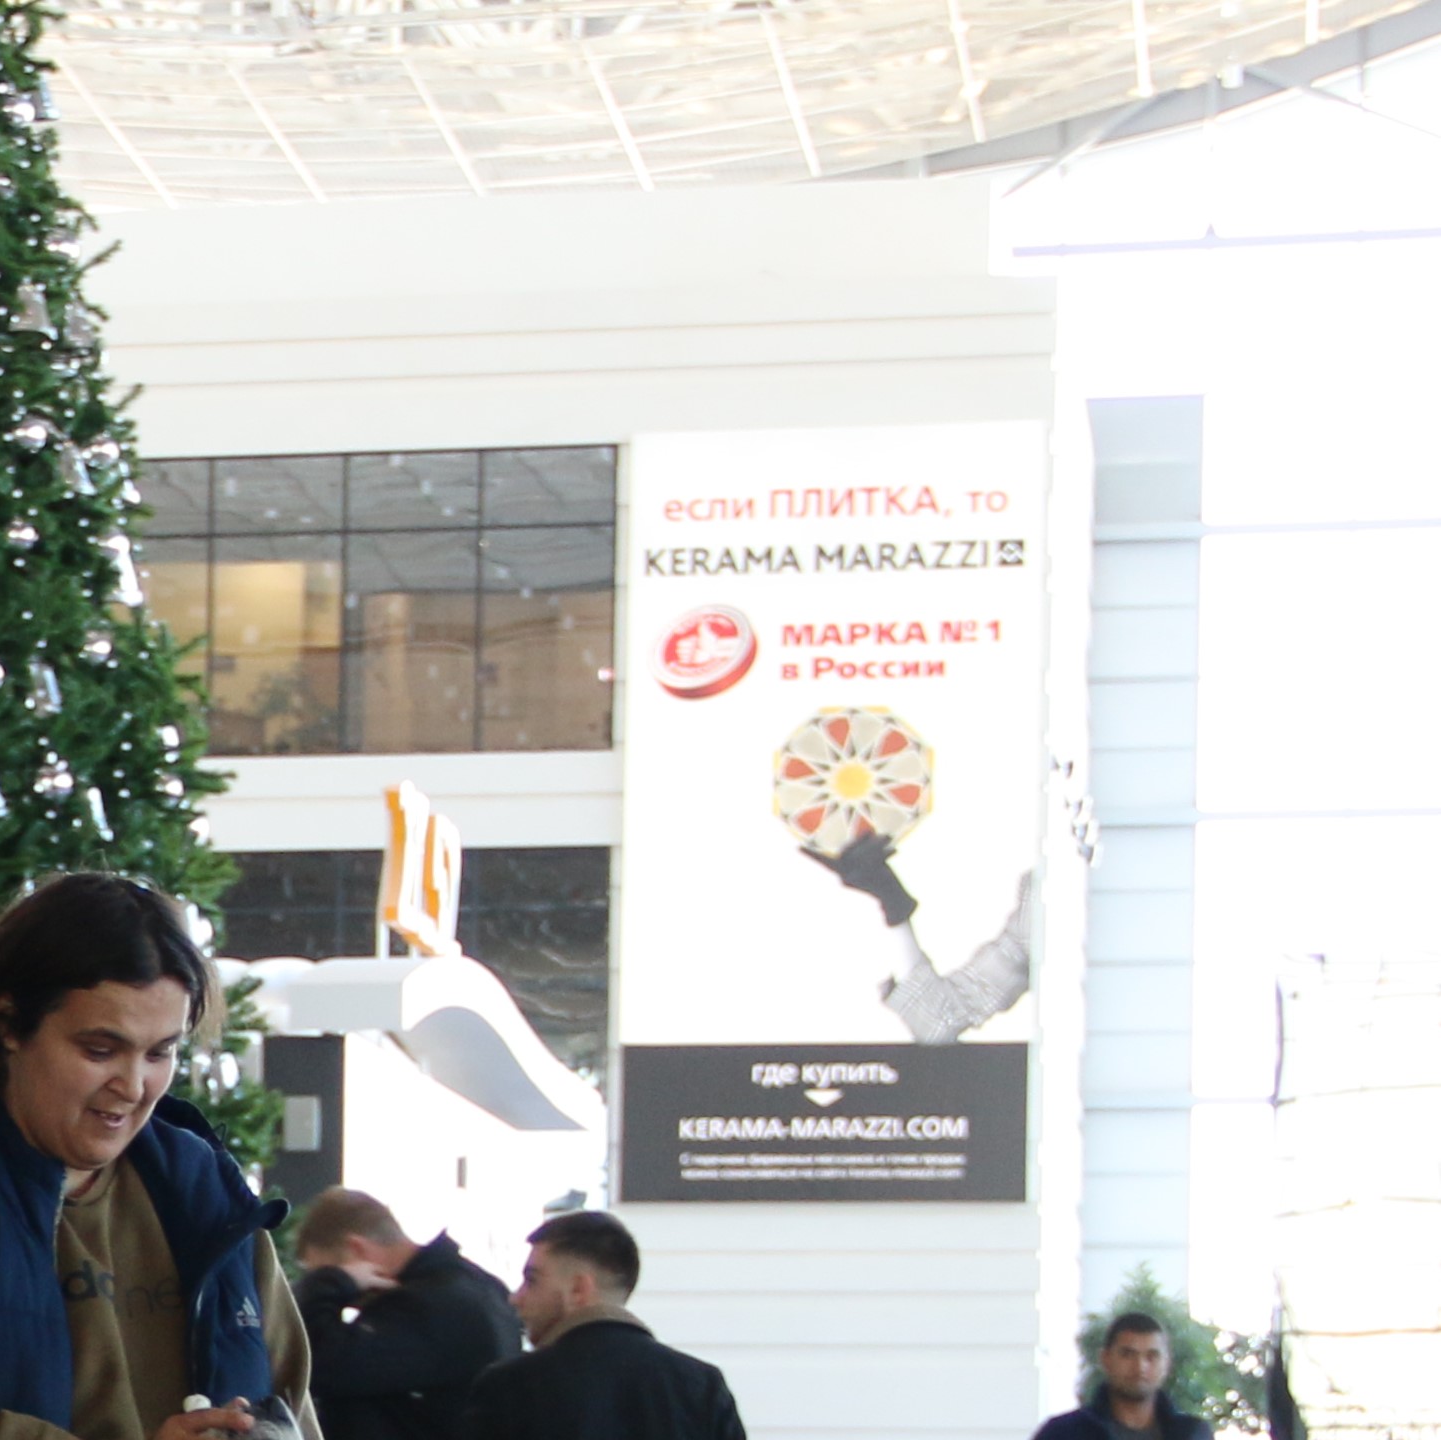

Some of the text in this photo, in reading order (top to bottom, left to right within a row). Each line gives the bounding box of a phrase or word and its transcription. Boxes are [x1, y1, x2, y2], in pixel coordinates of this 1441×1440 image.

[664, 486, 1008, 521] если ПЛИТКА, то
[645, 540, 989, 576] KERAMA MARAZZI
[781, 622, 927, 647] МАРКА
[781, 656, 946, 680] в России
[751, 1063, 899, 1088] где купить
[678, 1116, 968, 1140] KERAMA-MARAZZI.COM
